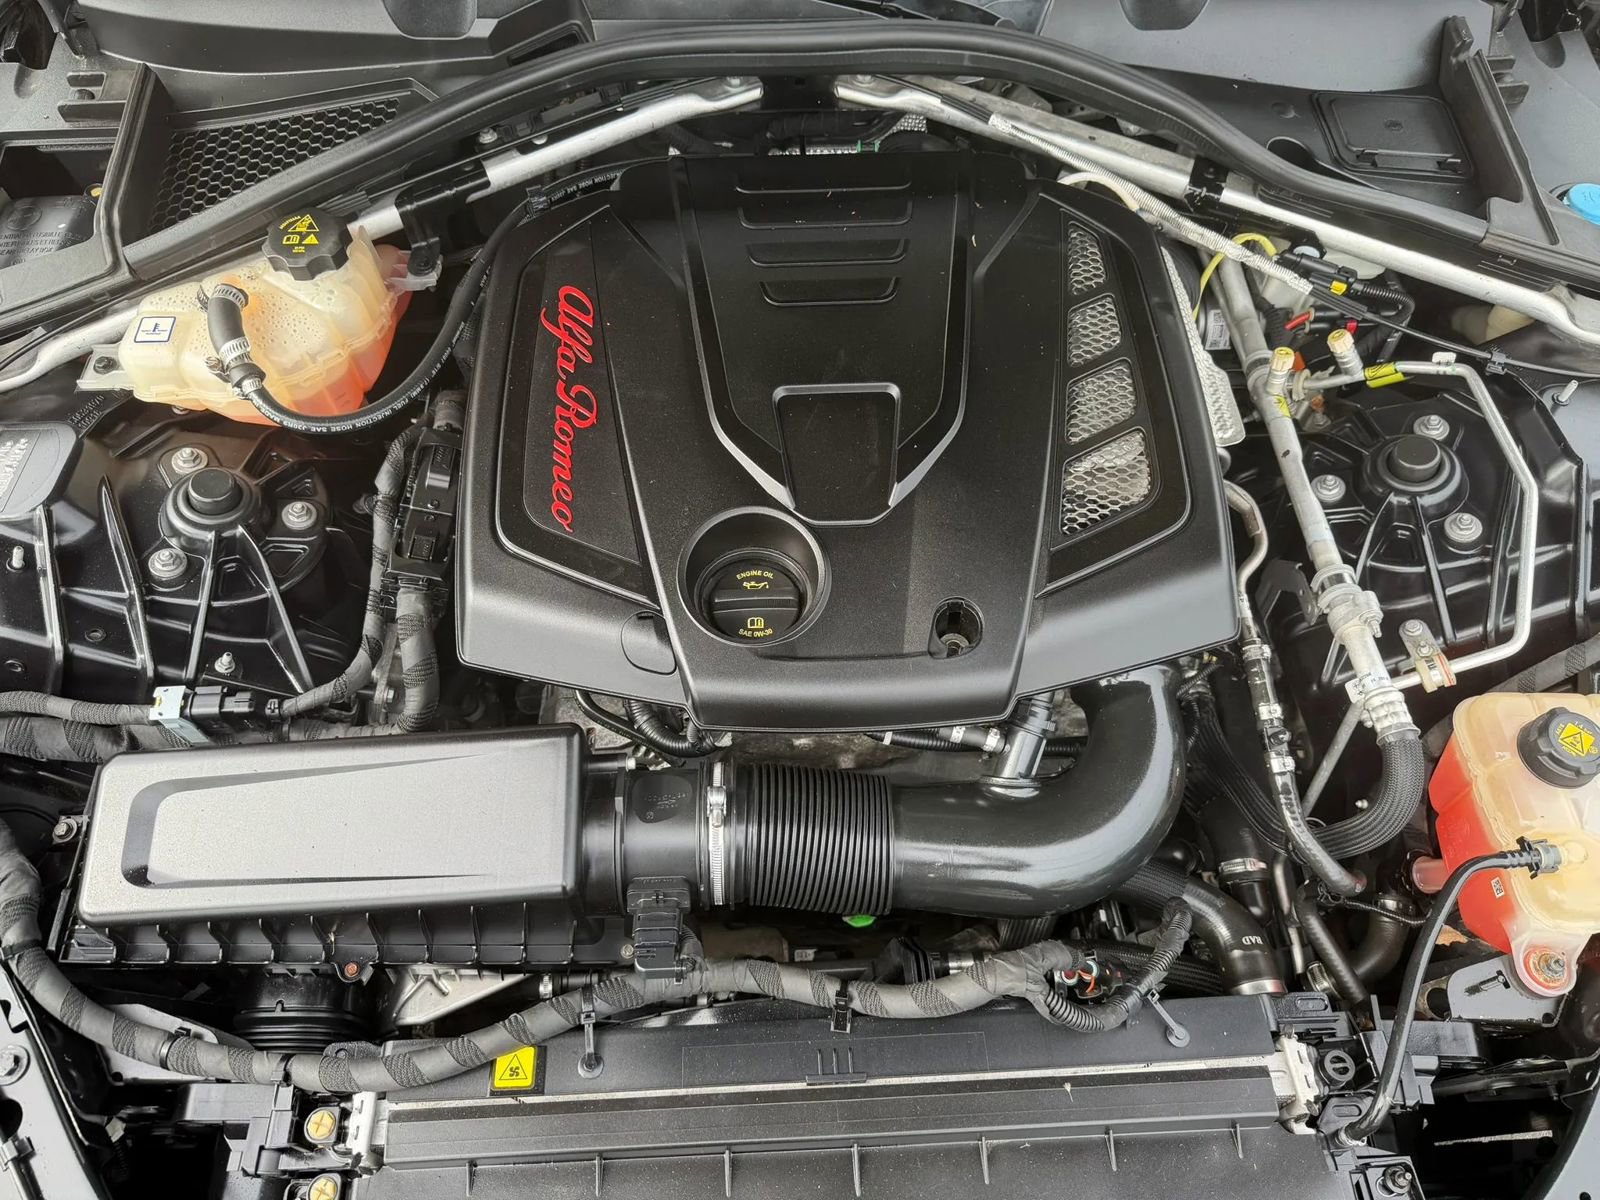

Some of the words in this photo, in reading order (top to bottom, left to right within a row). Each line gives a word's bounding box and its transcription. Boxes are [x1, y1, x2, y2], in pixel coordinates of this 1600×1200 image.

[540, 285, 594, 380] Alfa
[393, 398, 409, 410] FUEL
[355, 409, 392, 428] INJECTION
[331, 423, 353, 433] HOSE
[551, 380, 598, 533] Romeo
[736, 569, 762, 580] ENGINE
[763, 571, 774, 580] OIL
[738, 628, 752, 637] SAE
[753, 628, 773, 638] 0W-30
[1242, 935, 1264, 945] RAD
